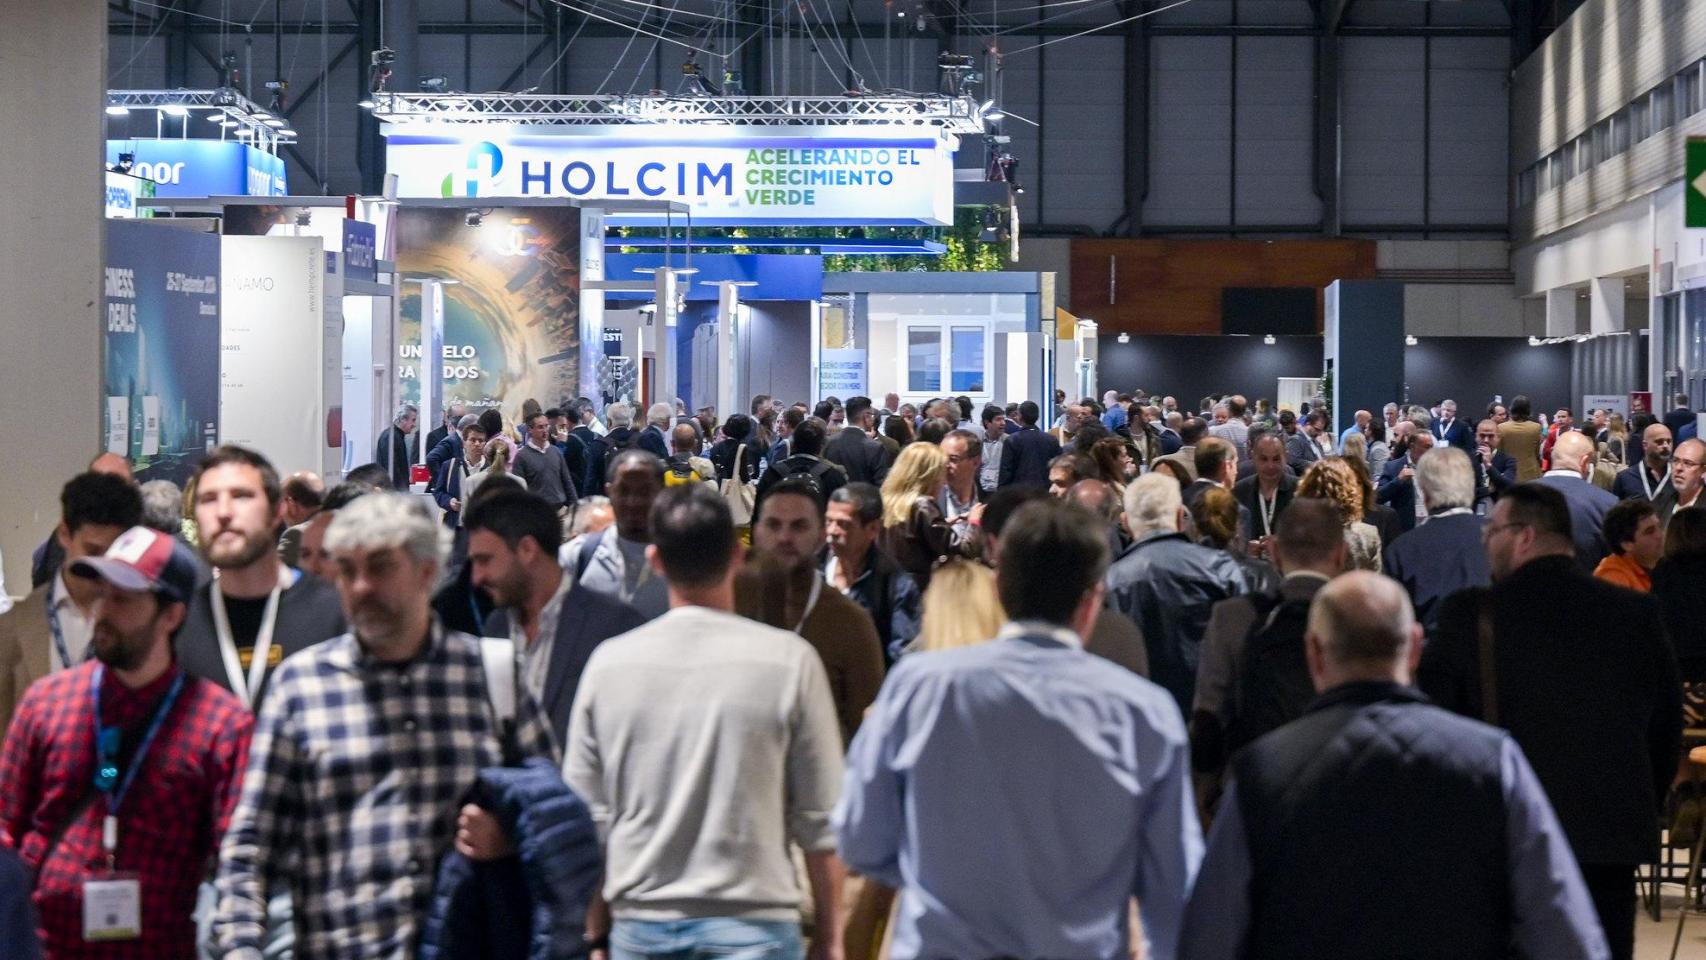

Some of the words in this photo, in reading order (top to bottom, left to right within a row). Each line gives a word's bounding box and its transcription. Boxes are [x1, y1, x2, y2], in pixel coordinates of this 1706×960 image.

[745, 149, 890, 165] ACELERANDO
[897, 149, 921, 165] EL
[521, 161, 733, 196] HOLCIM
[745, 169, 894, 186] CRECIMIENTO
[745, 189, 816, 205] VERDE
[442, 345, 476, 358] ELO
[442, 365, 479, 379] DOS
